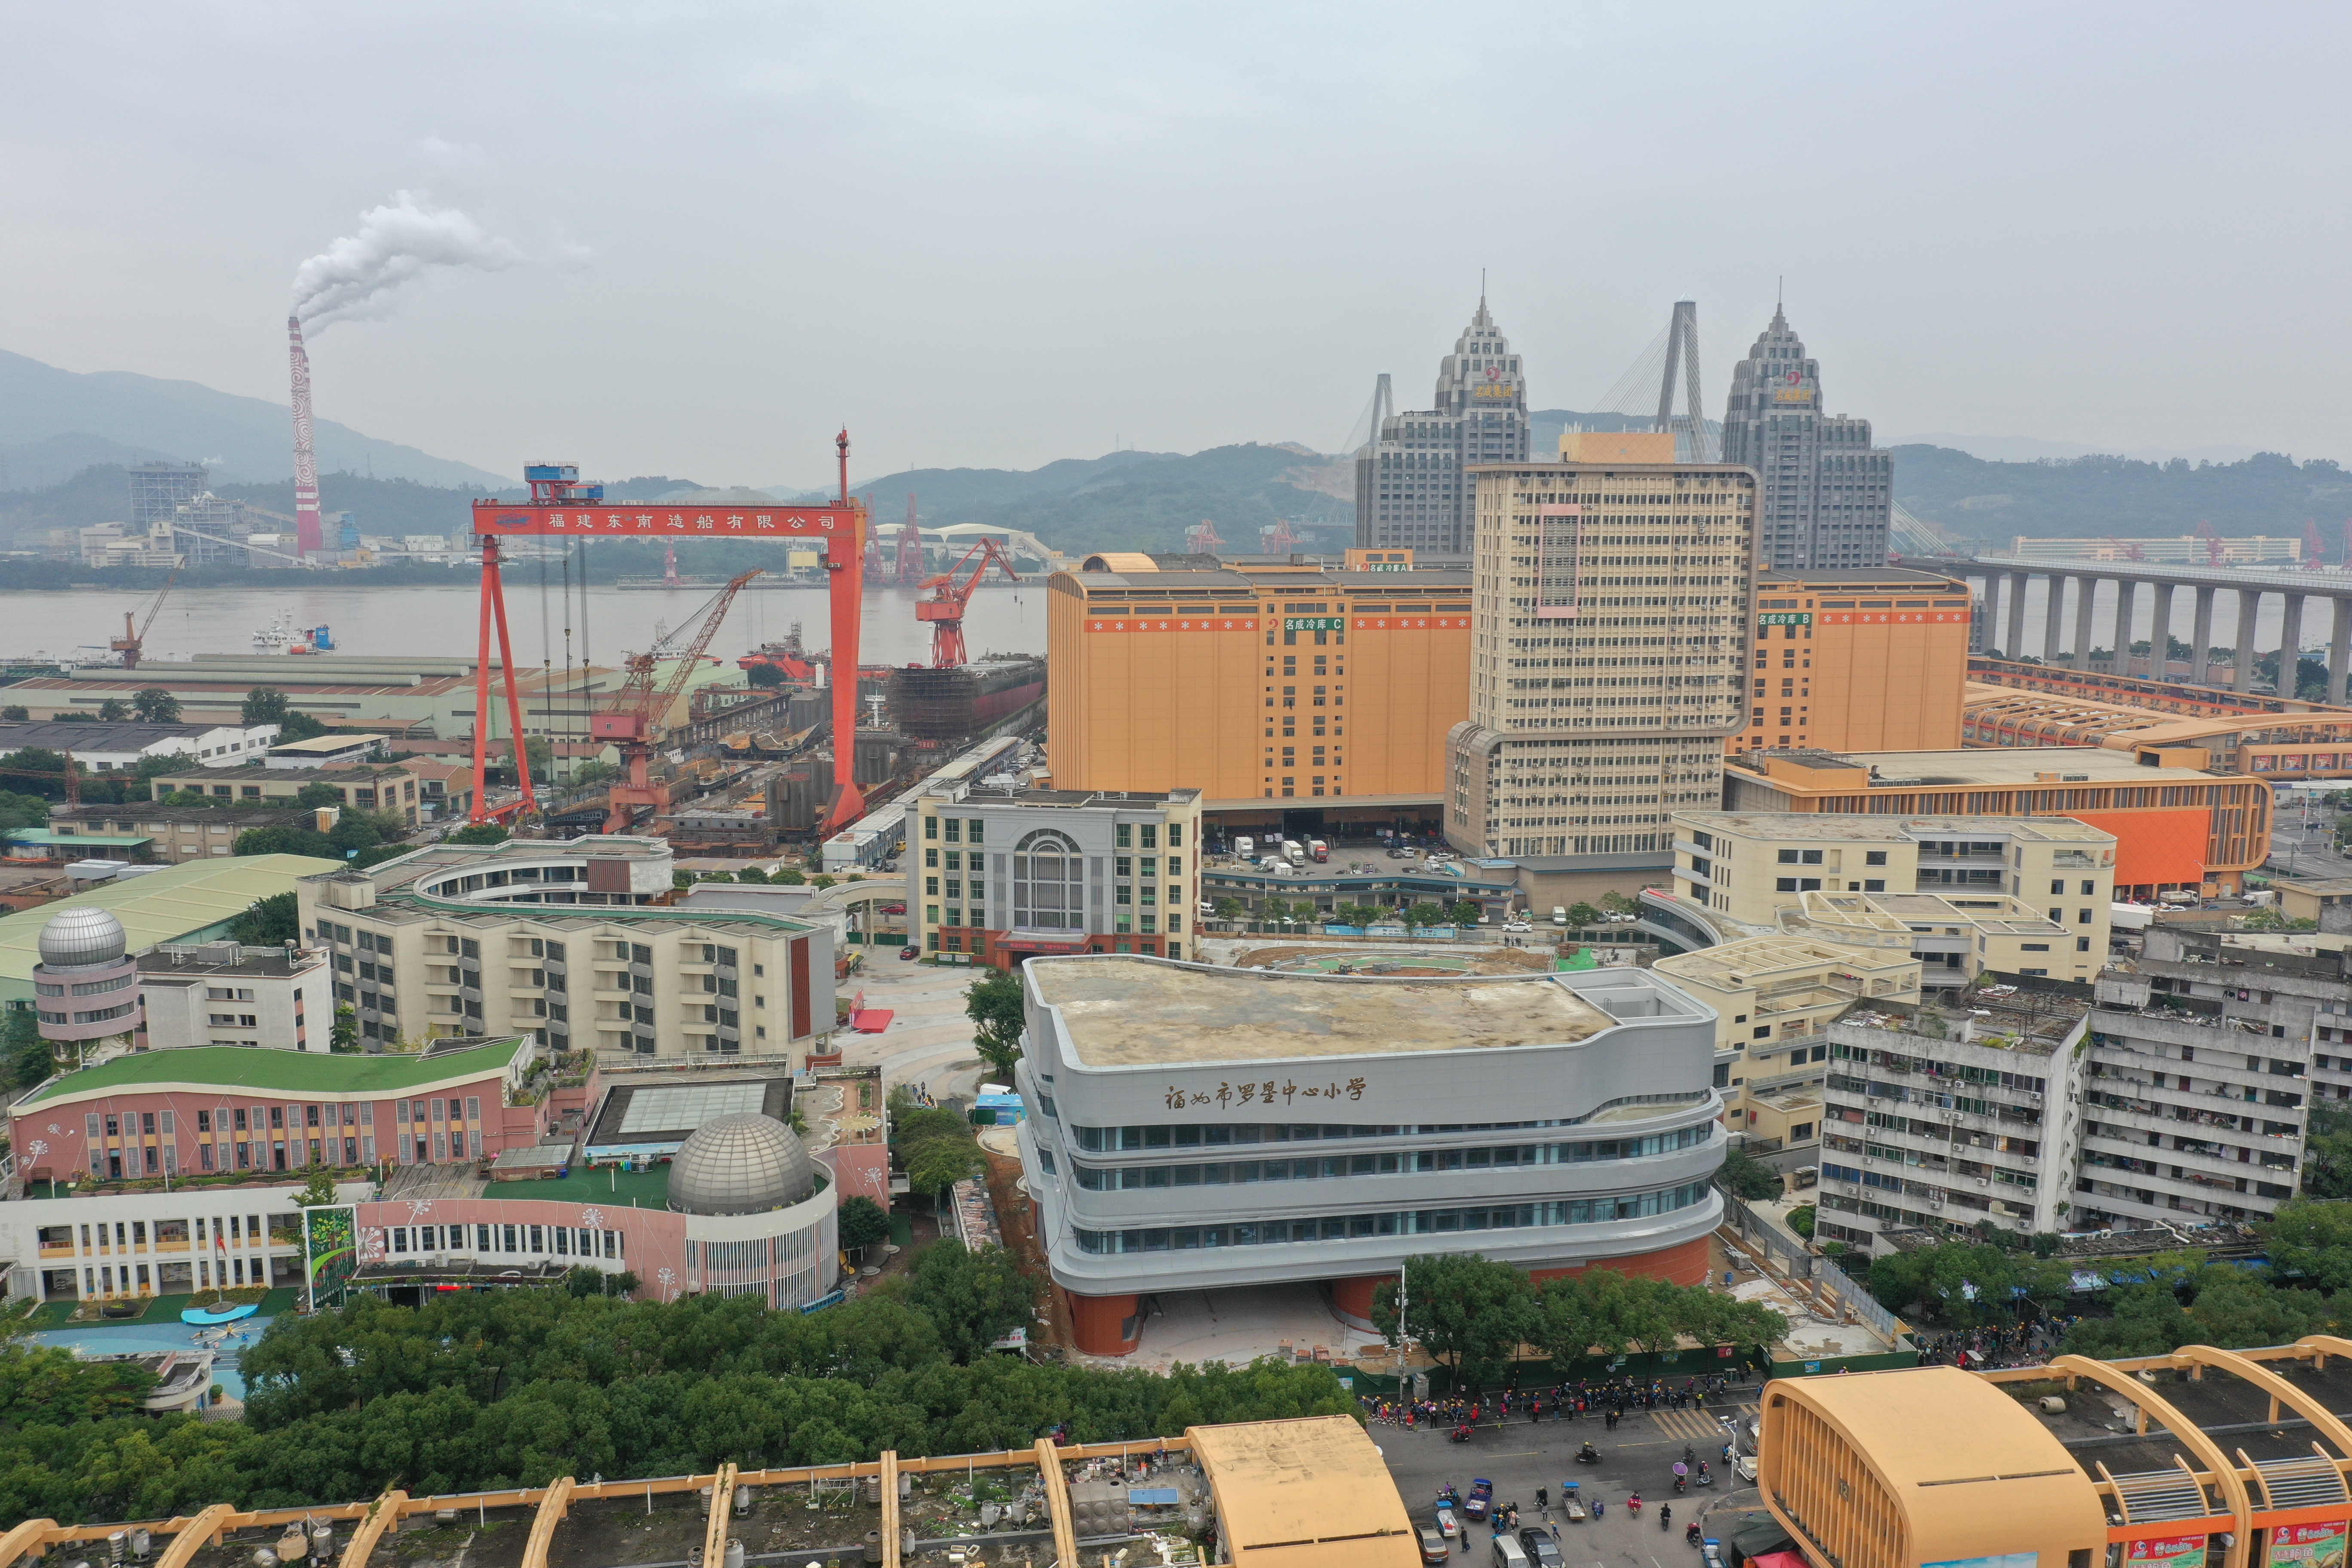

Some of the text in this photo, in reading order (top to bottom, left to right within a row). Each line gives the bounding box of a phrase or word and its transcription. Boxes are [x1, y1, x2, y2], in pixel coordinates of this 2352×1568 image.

[1474, 385, 1513, 398] 名成集团
[1775, 389, 1810, 402] 名成集团
[548, 514, 835, 530] 福建东南造船有限公司
[1286, 619, 1341, 630] 名成冷库 C
[1758, 614, 1809, 625] 名成冷库 B
[1164, 1076, 1366, 1110] 福州市罗星中心小学
[1840, 1482, 1847, 1499] 12
